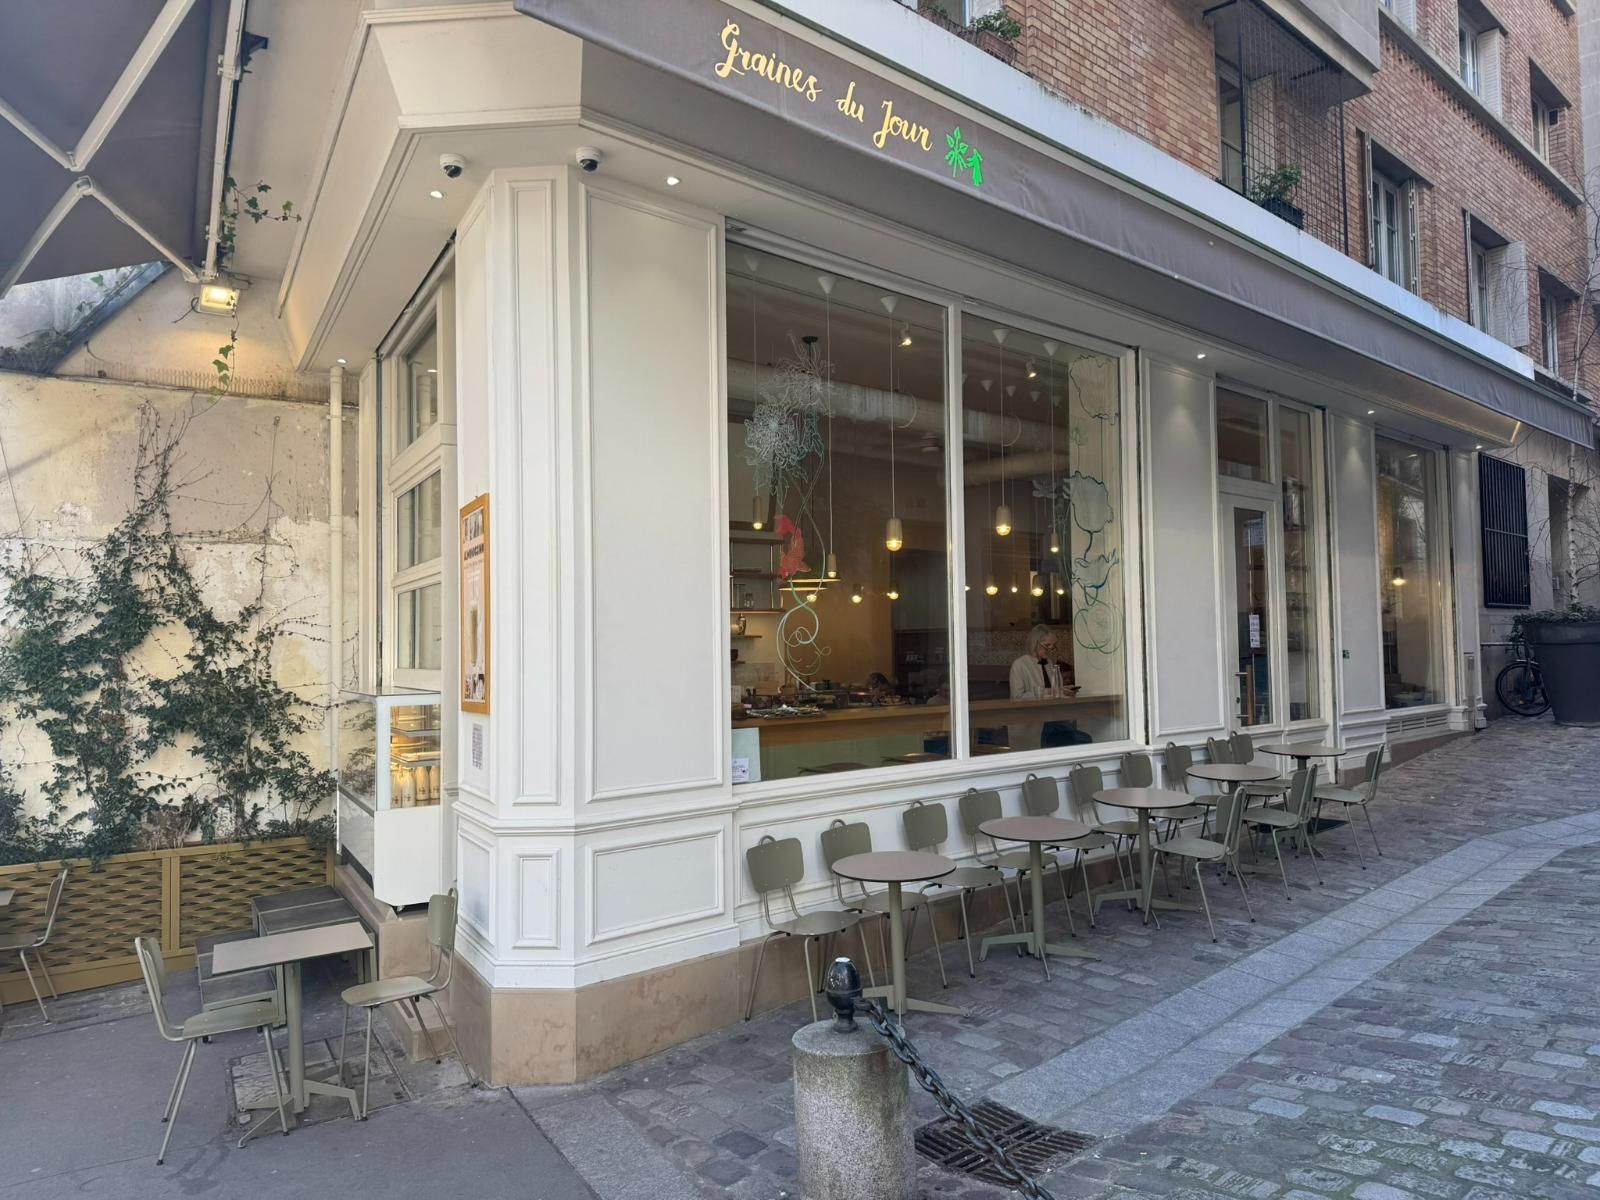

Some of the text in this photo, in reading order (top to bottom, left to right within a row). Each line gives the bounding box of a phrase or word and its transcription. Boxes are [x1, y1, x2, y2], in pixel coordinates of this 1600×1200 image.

[714, 18, 933, 151] Graines du Jour
